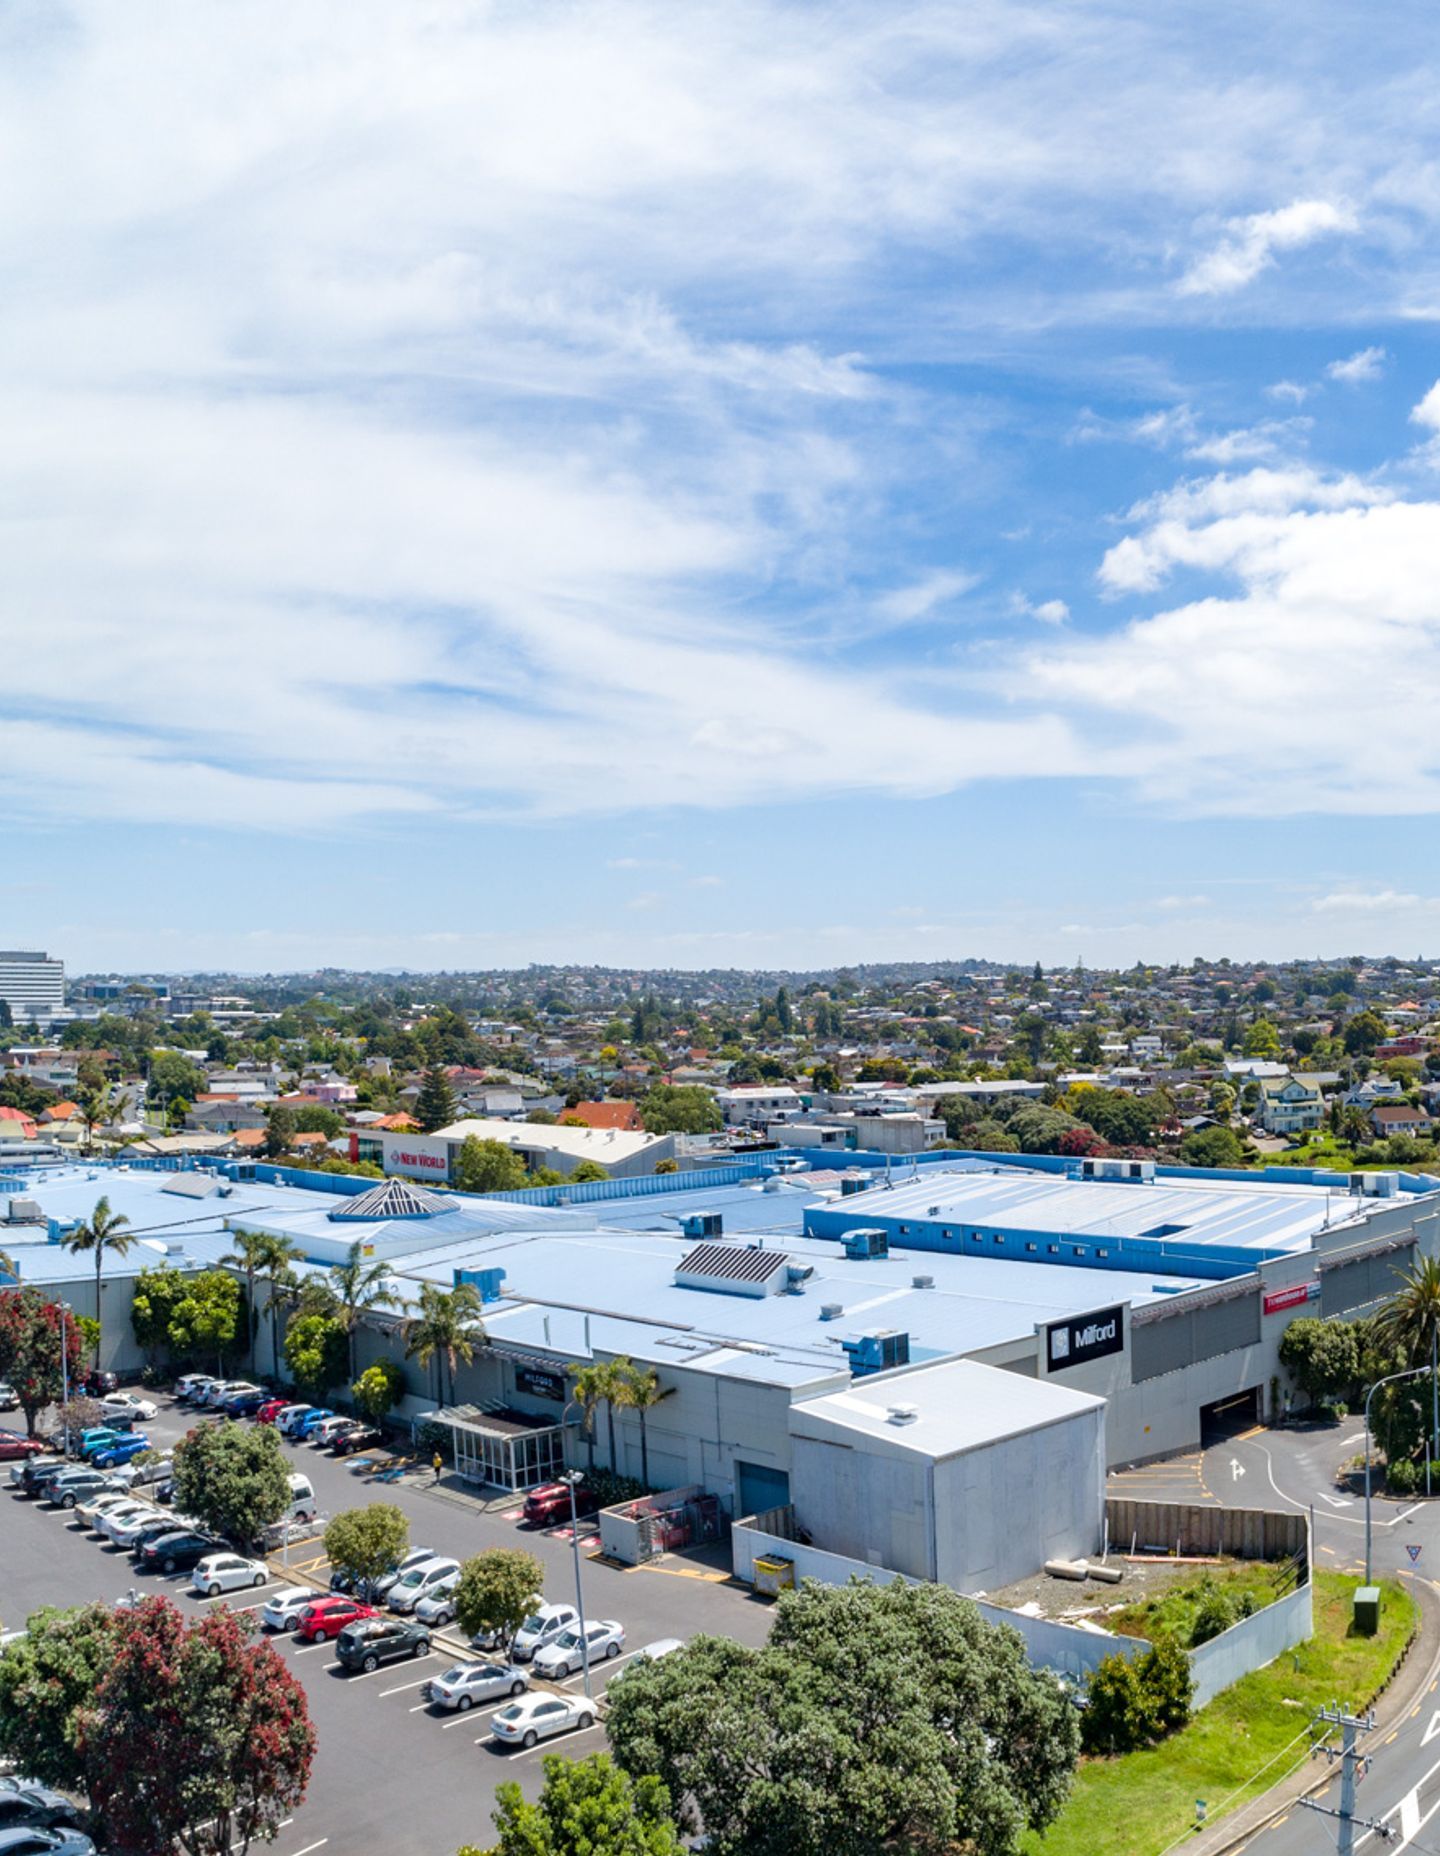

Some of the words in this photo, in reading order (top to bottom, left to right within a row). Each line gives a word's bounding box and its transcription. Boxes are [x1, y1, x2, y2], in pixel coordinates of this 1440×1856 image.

[401, 1152, 417, 1166] NEW
[418, 1153, 446, 1169] WORLD
[1075, 1319, 1116, 1349] Milford
